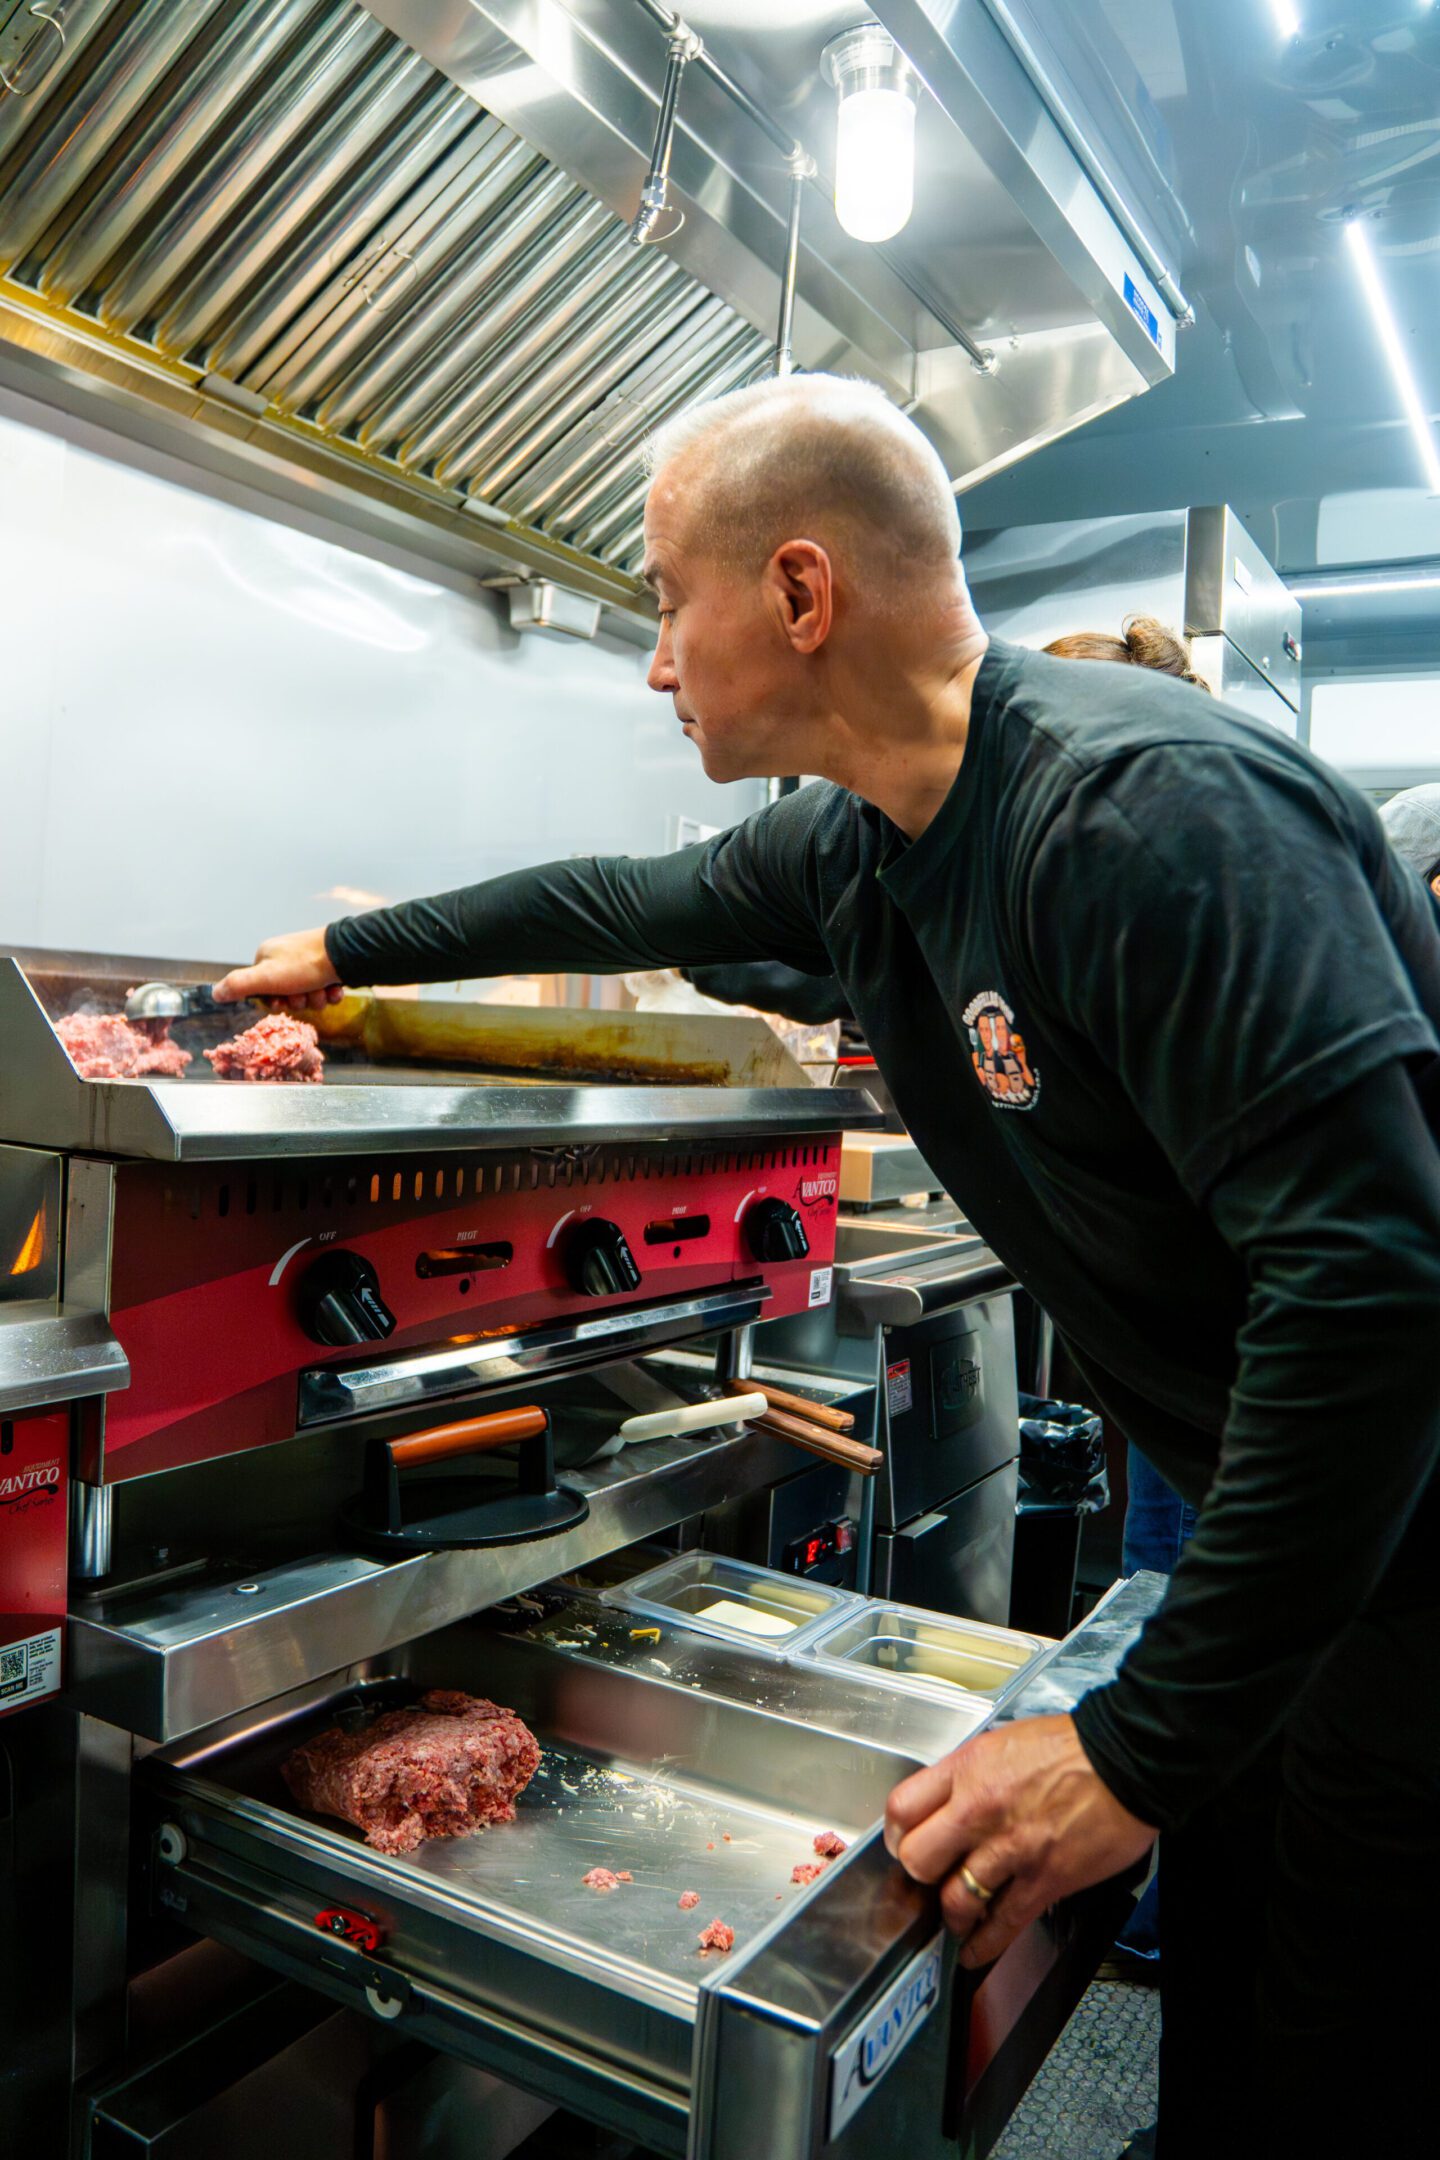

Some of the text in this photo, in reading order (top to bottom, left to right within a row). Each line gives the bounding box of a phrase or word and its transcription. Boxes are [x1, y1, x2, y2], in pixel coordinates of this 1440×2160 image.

[792, 1175, 837, 1205] AVANTCO
[319, 1230, 337, 1241] OFF
[456, 1230, 478, 1241] PILOT
[0, 1466, 60, 1496] VANTCO
